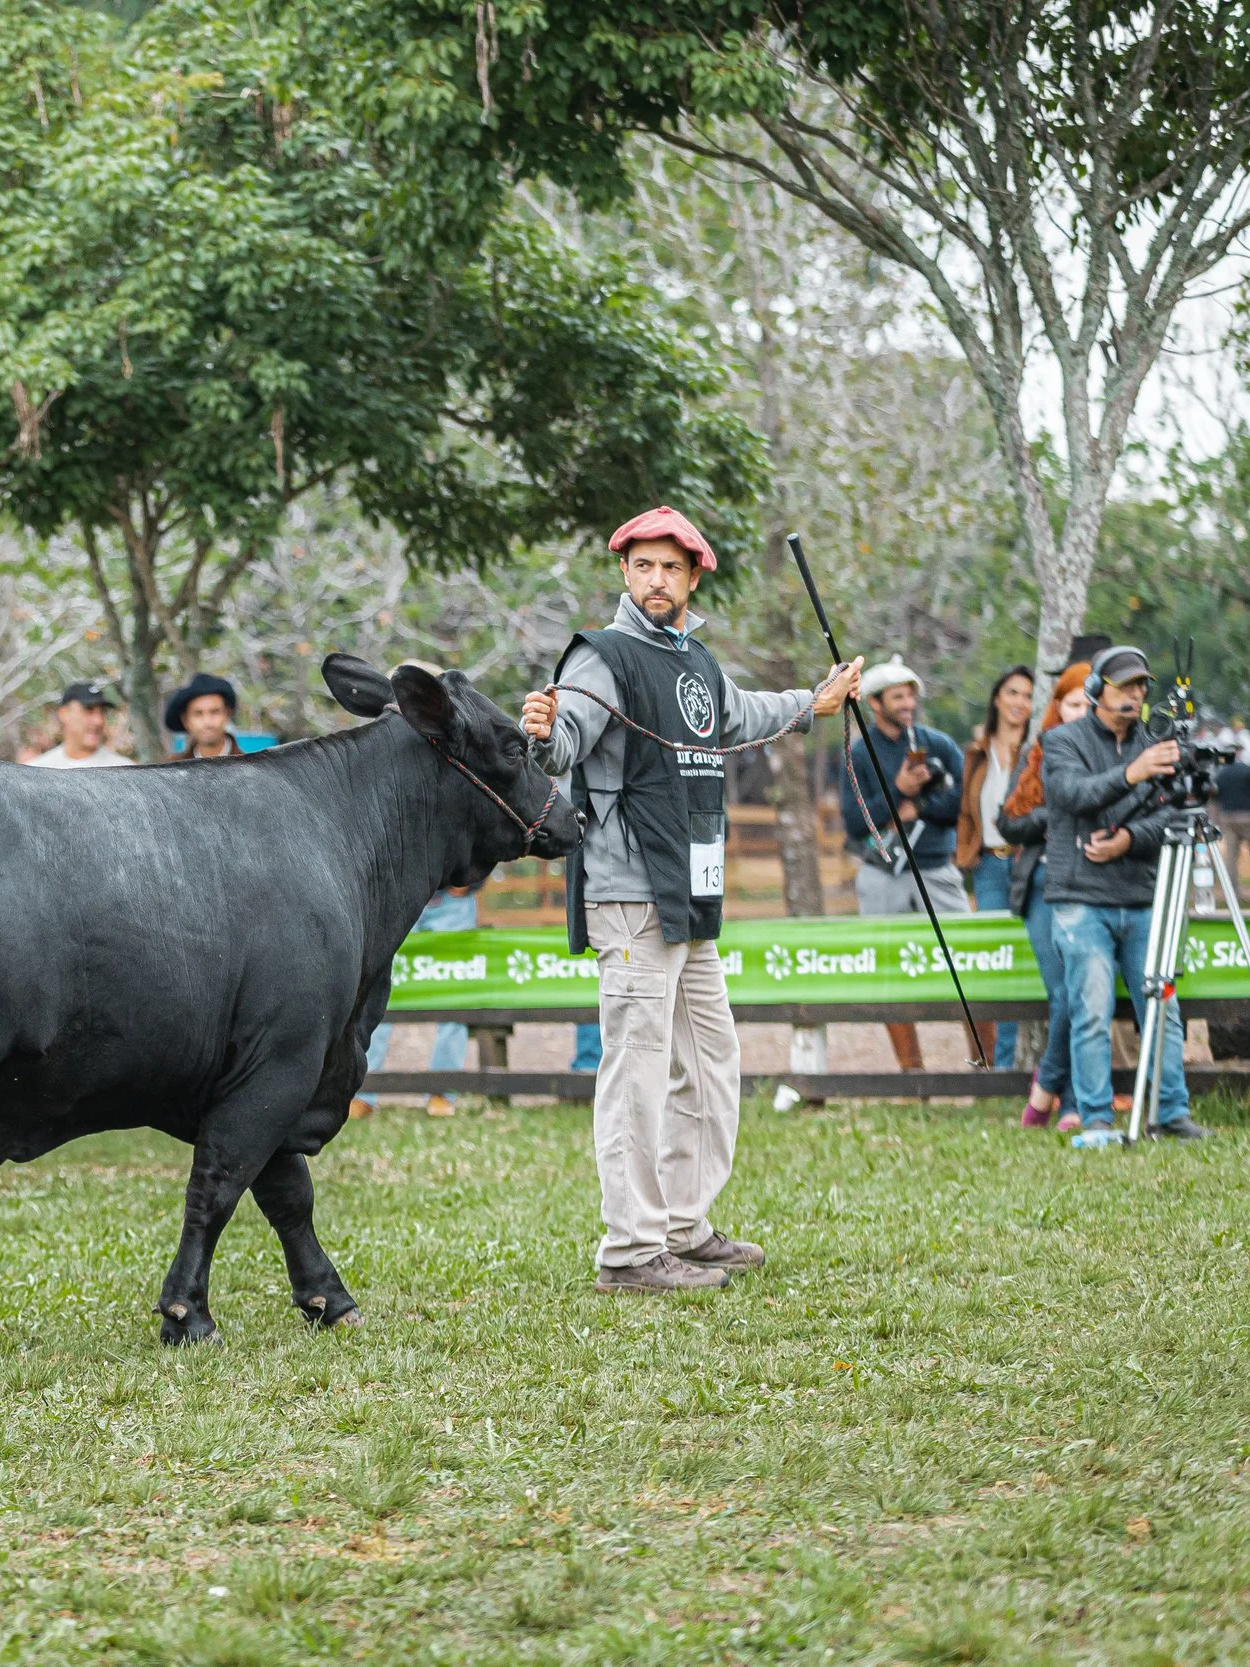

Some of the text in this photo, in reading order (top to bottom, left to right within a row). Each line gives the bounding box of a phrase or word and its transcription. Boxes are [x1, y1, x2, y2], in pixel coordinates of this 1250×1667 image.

[673, 742, 723, 768] Brangu
[412, 954, 487, 981] Sicredi
[535, 952, 600, 979] Sicre
[796, 947, 876, 974] Sicredi
[931, 944, 1013, 971] Sicredi
